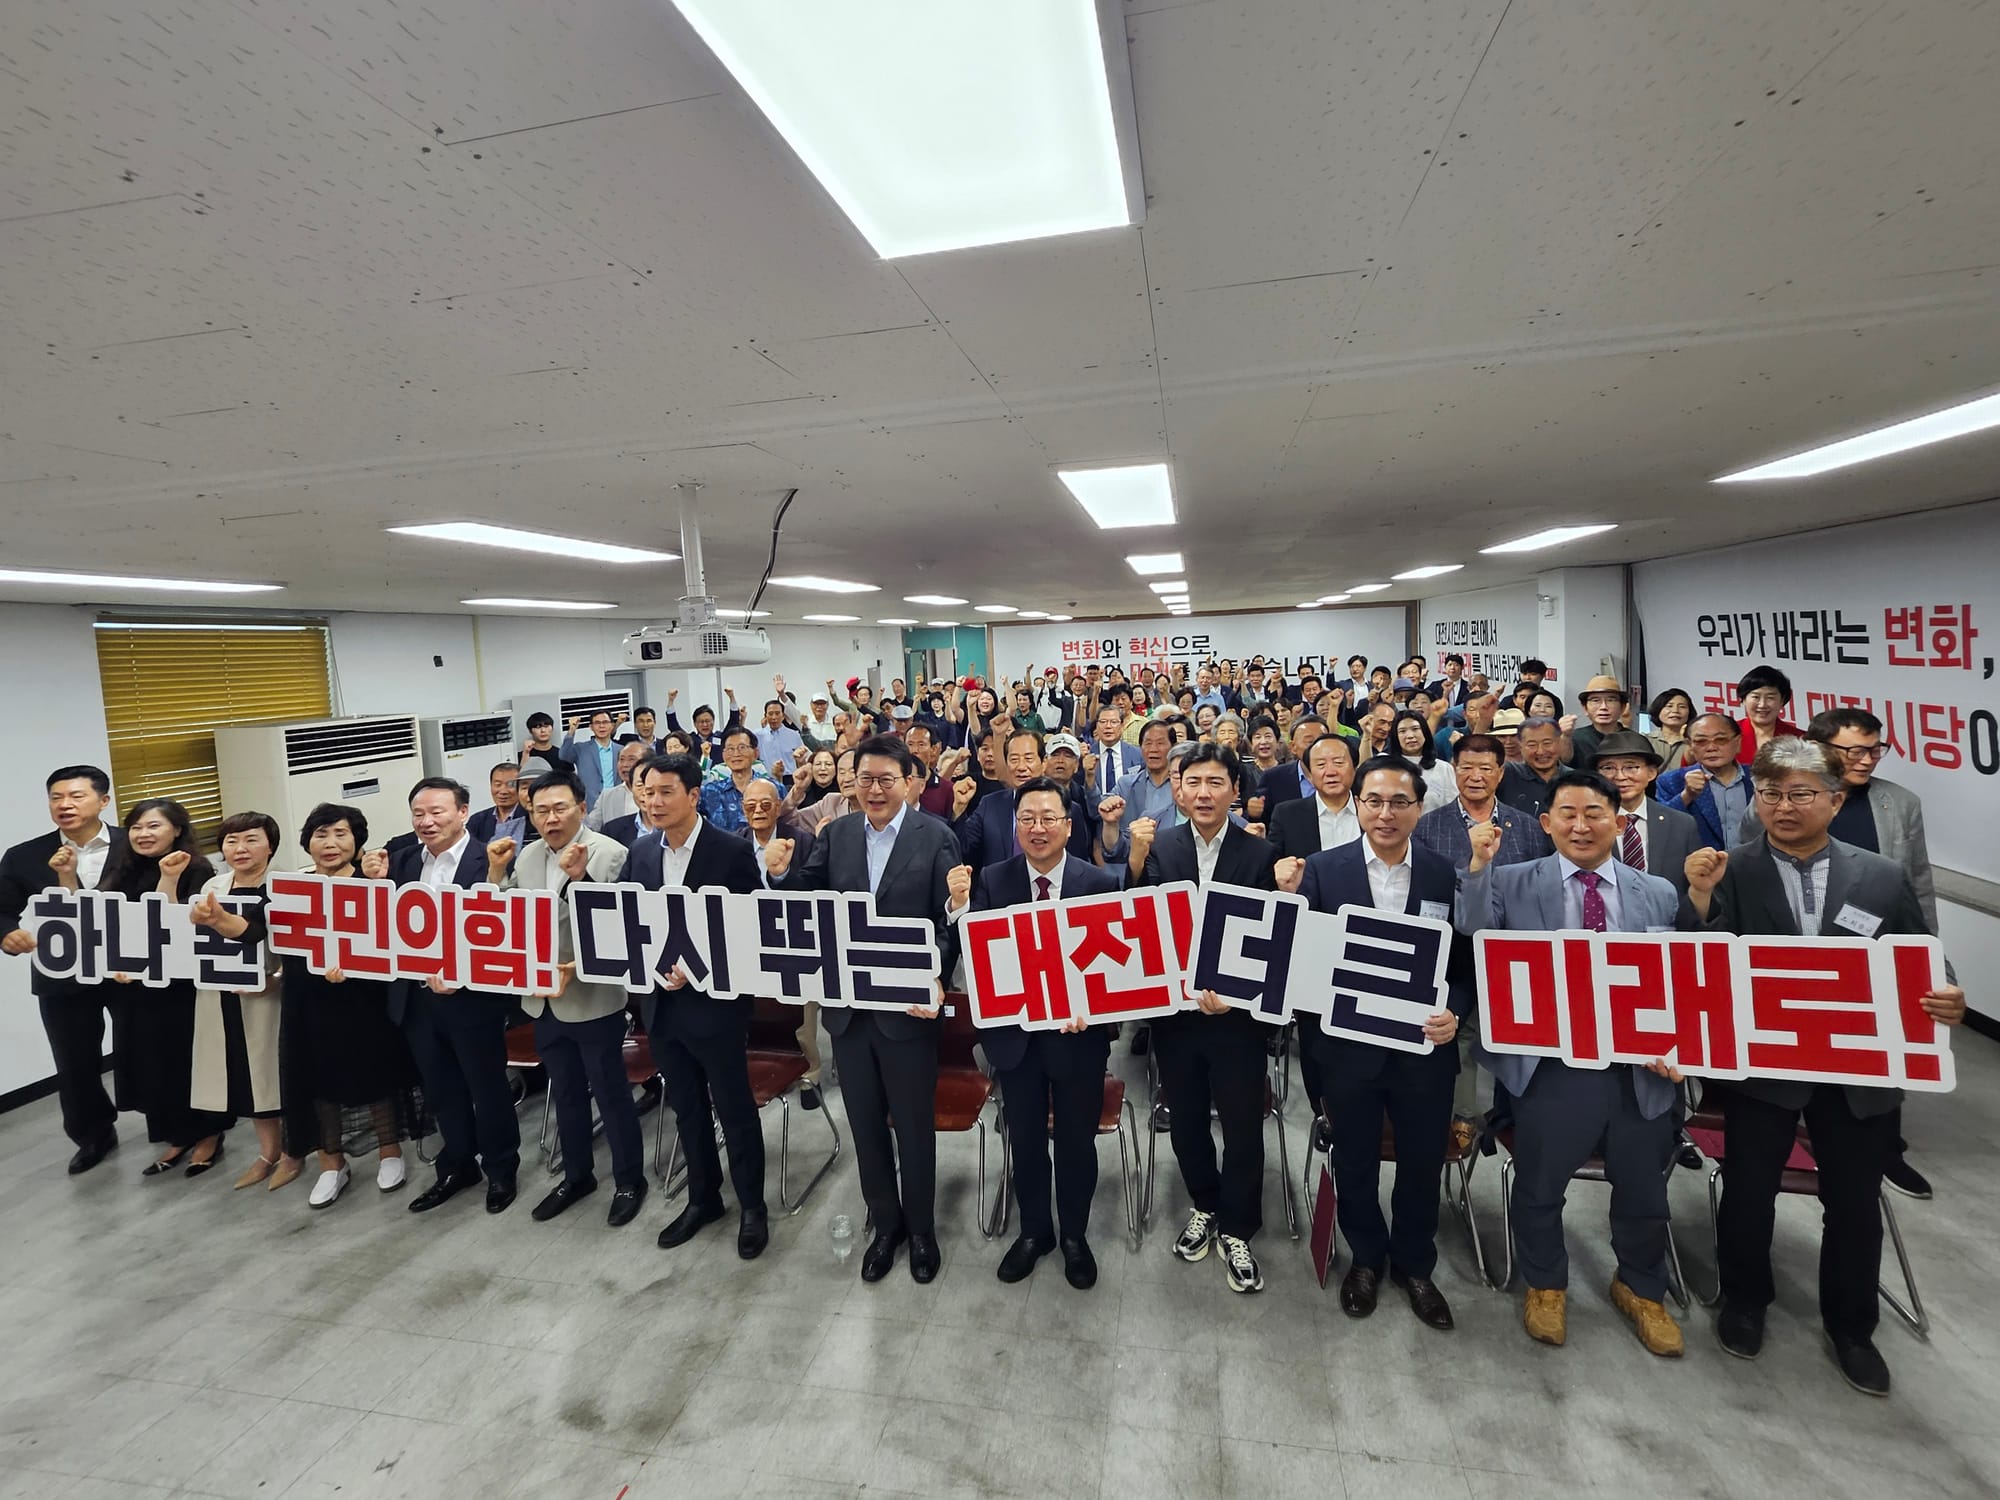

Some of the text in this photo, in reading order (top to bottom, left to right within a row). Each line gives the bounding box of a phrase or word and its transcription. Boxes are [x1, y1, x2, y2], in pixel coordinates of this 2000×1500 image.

[1061, 634, 1218, 660] 변화와 혁신으로,
[1435, 618, 1498, 648] 대전시민의 편에서
[1697, 604, 1994, 680] 우리가 바라는 변화,
[34, 893, 171, 981] 하나
[269, 878, 553, 989] 국민의힘!
[574, 890, 932, 1005] 다시 뛰는
[967, 889, 1194, 1022] 대전!
[1194, 891, 1442, 1044] 더 큰
[1484, 938, 1940, 1081] 미래로!
